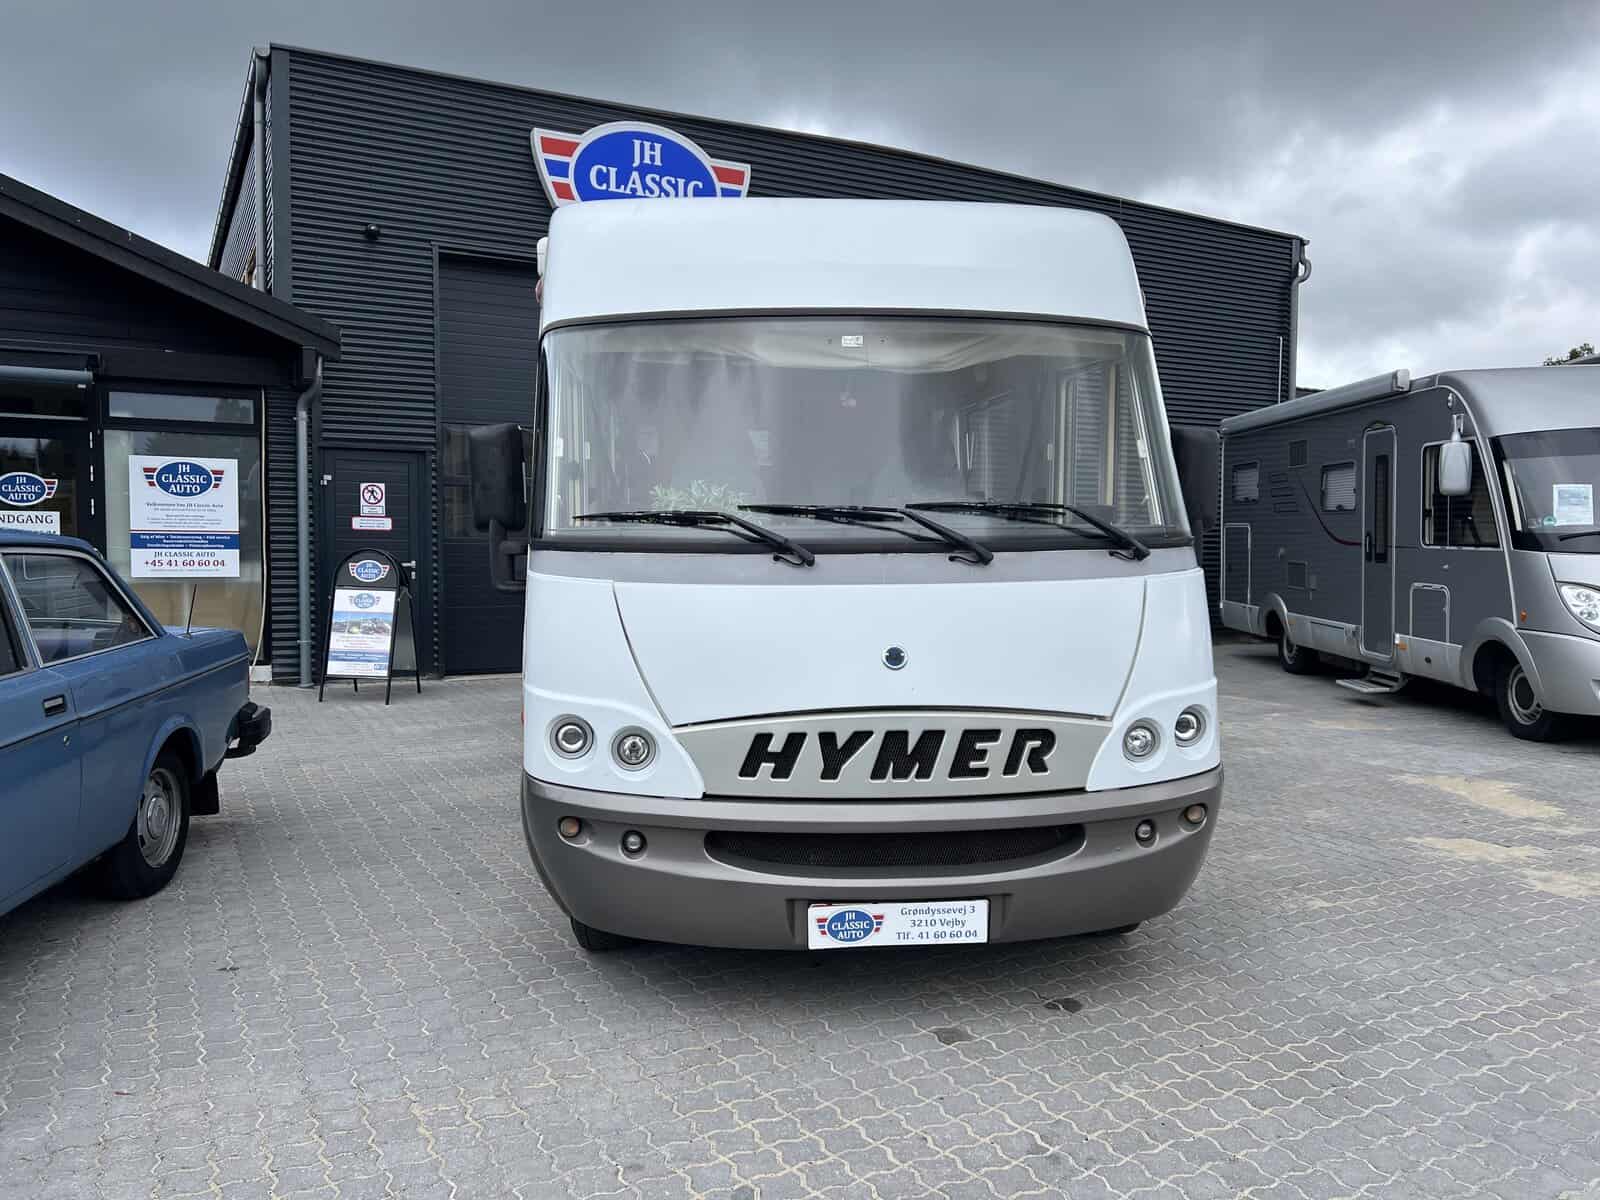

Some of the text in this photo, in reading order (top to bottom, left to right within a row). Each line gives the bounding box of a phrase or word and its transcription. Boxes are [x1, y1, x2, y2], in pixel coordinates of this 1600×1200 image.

[632, 139, 662, 167] JH
[590, 164, 703, 198] CLASSIC
[178, 464, 190, 473] JH
[16, 476, 27, 484] JH
[162, 474, 207, 484] CLASSIC
[1, 484, 41, 493] CLASSIC
[168, 484, 201, 493] AUTO
[8, 492, 36, 501] AUTO
[145, 559, 225, 567] +45 41 60 60 04
[738, 728, 1057, 783] HYMER
[900, 905, 976, 916] Grøndyssevej 3
[845, 912, 856, 921] JH
[831, 920, 870, 931] CLASSIC
[910, 918, 967, 929] 3210 Vejby
[837, 930, 864, 940] AUTO
[918, 931, 930, 939] 41
[933, 930, 947, 939] 60
[949, 930, 963, 939] 60
[964, 929, 978, 938] 04
